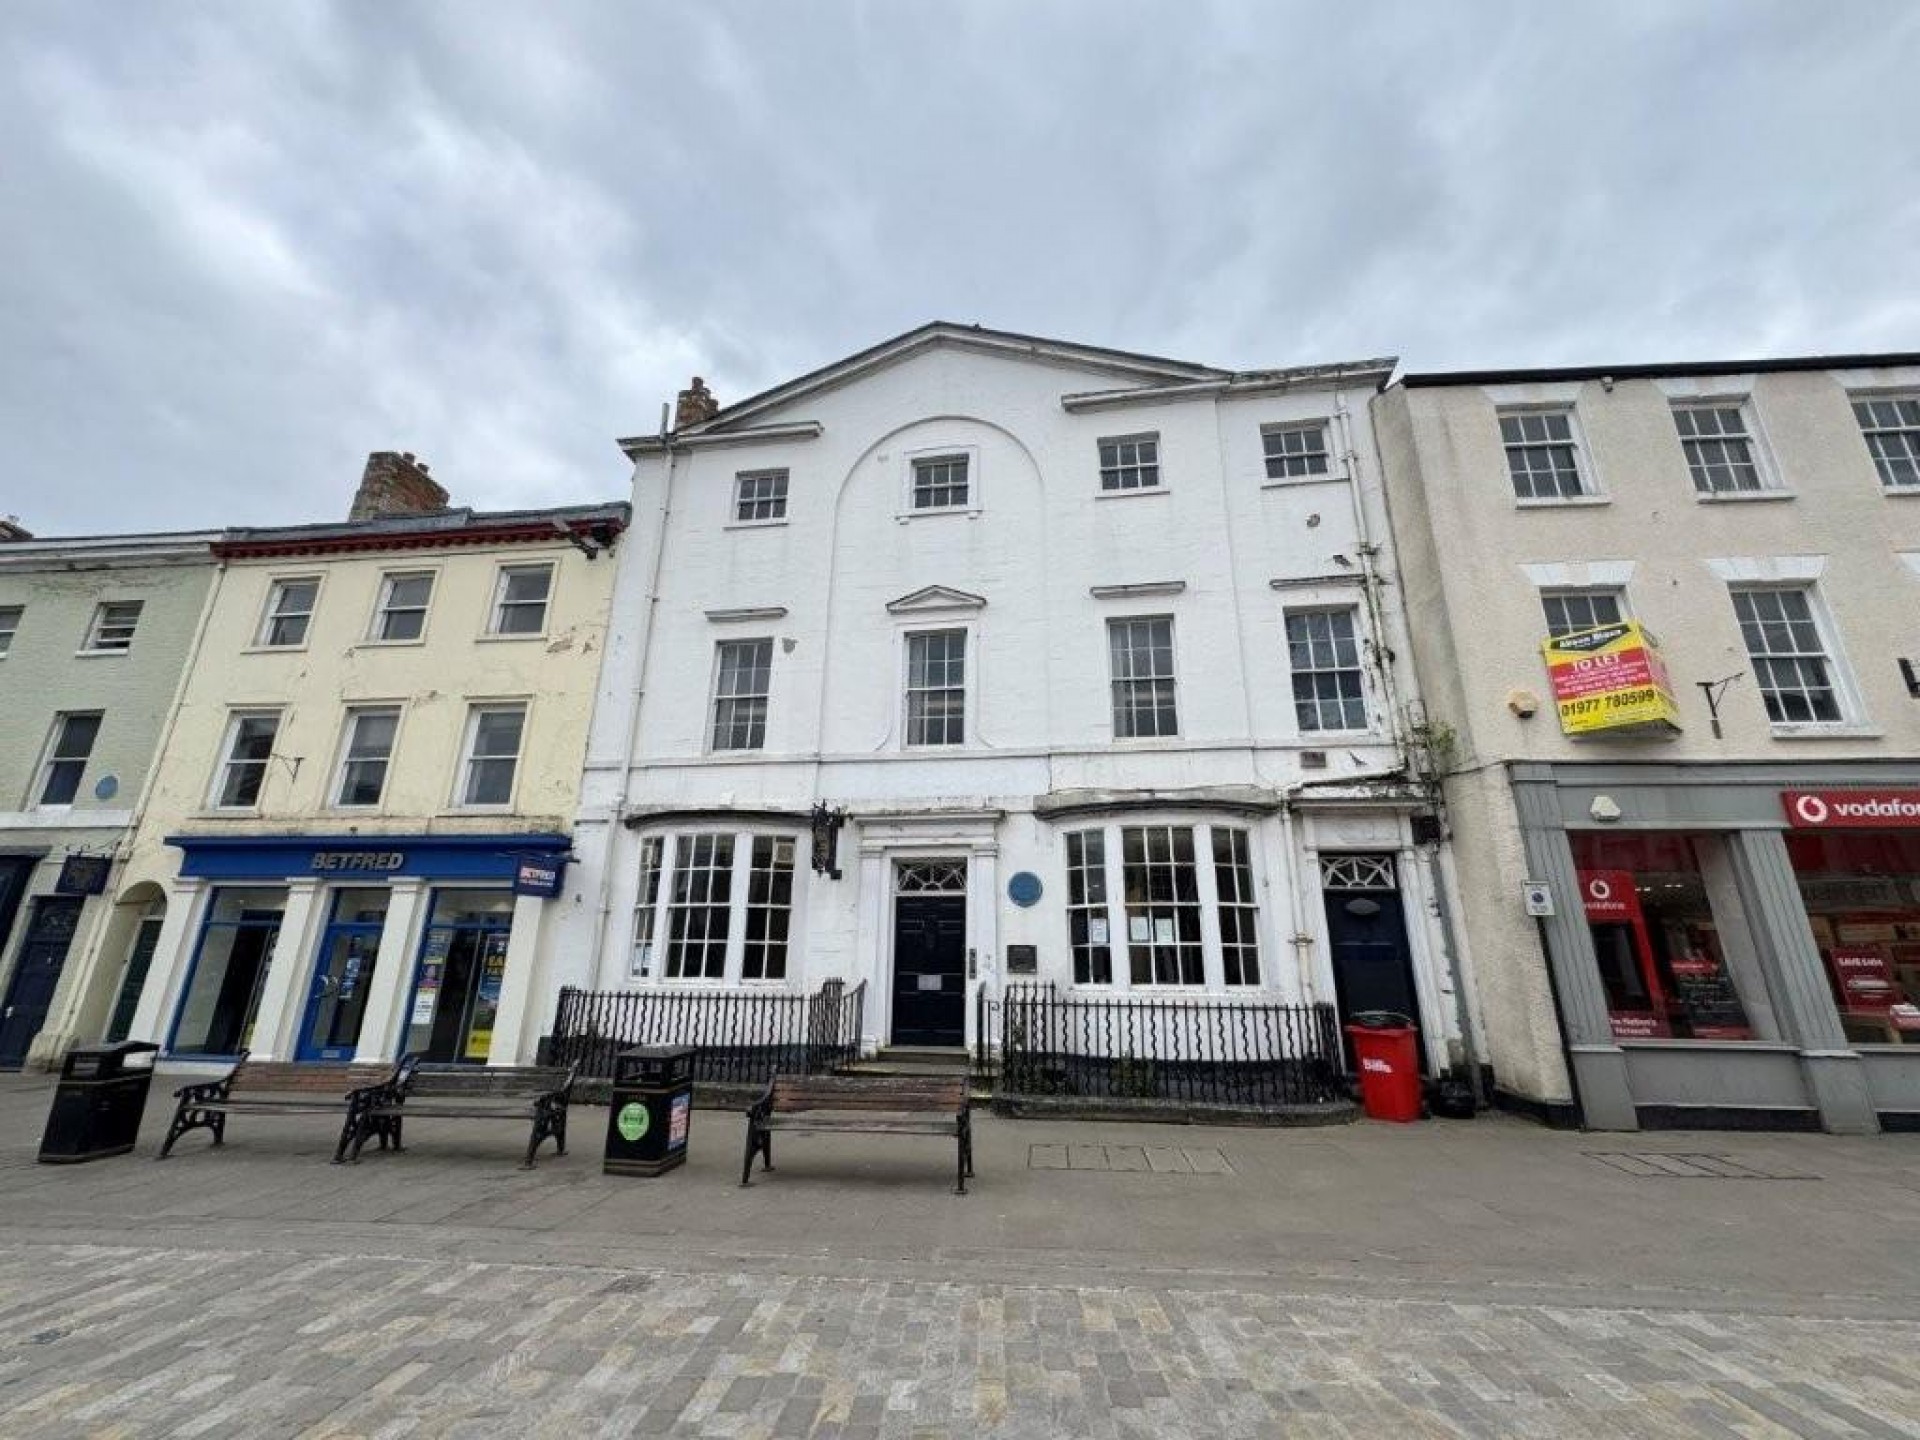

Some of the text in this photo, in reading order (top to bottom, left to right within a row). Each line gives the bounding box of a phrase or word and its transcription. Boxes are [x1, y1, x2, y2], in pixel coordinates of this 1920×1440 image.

[1571, 653, 1621, 673] TO LET
[1561, 698, 1600, 716] 01977
[312, 852, 404, 869] BETFRED
